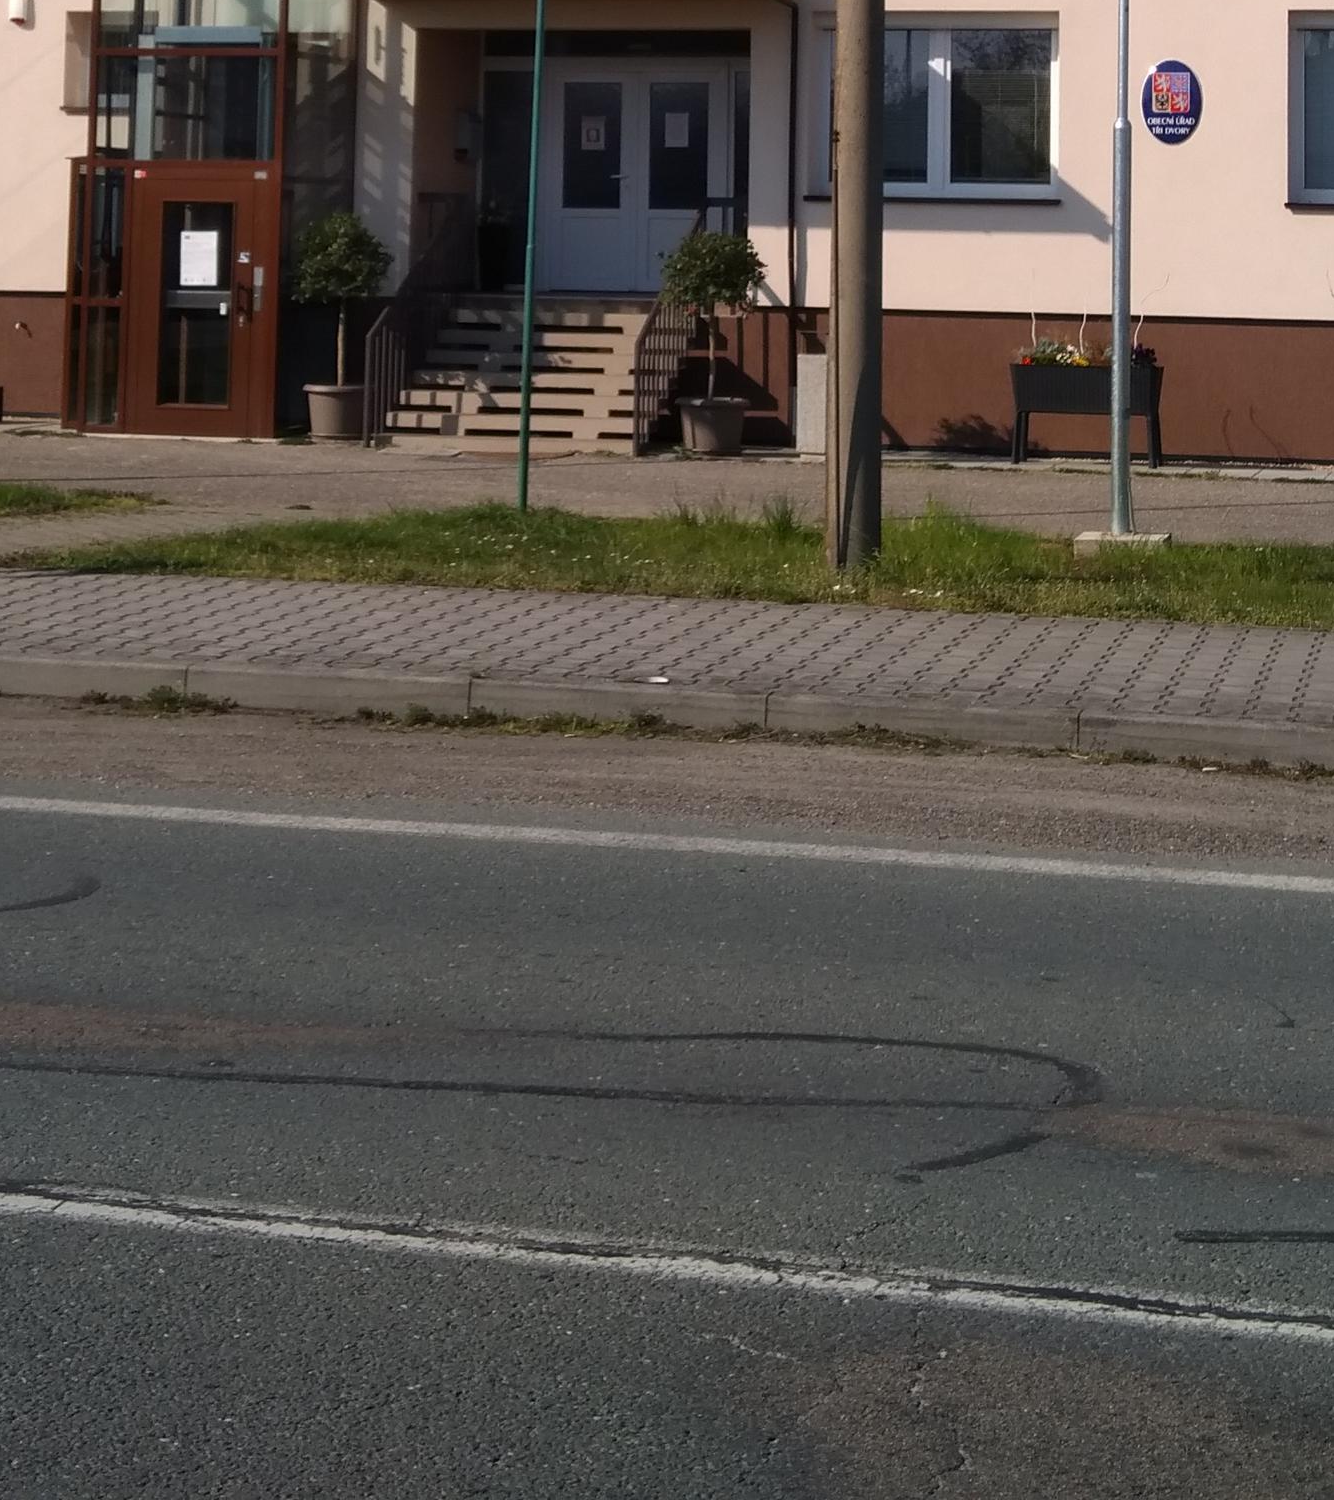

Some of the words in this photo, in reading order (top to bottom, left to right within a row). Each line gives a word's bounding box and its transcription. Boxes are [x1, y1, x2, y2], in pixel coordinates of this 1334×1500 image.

[1147, 116, 1174, 125] OBECNÍ
[1175, 116, 1196, 125] ÚŘAD
[1152, 125, 1163, 134] TŘI
[1165, 126, 1190, 134] DVORY
